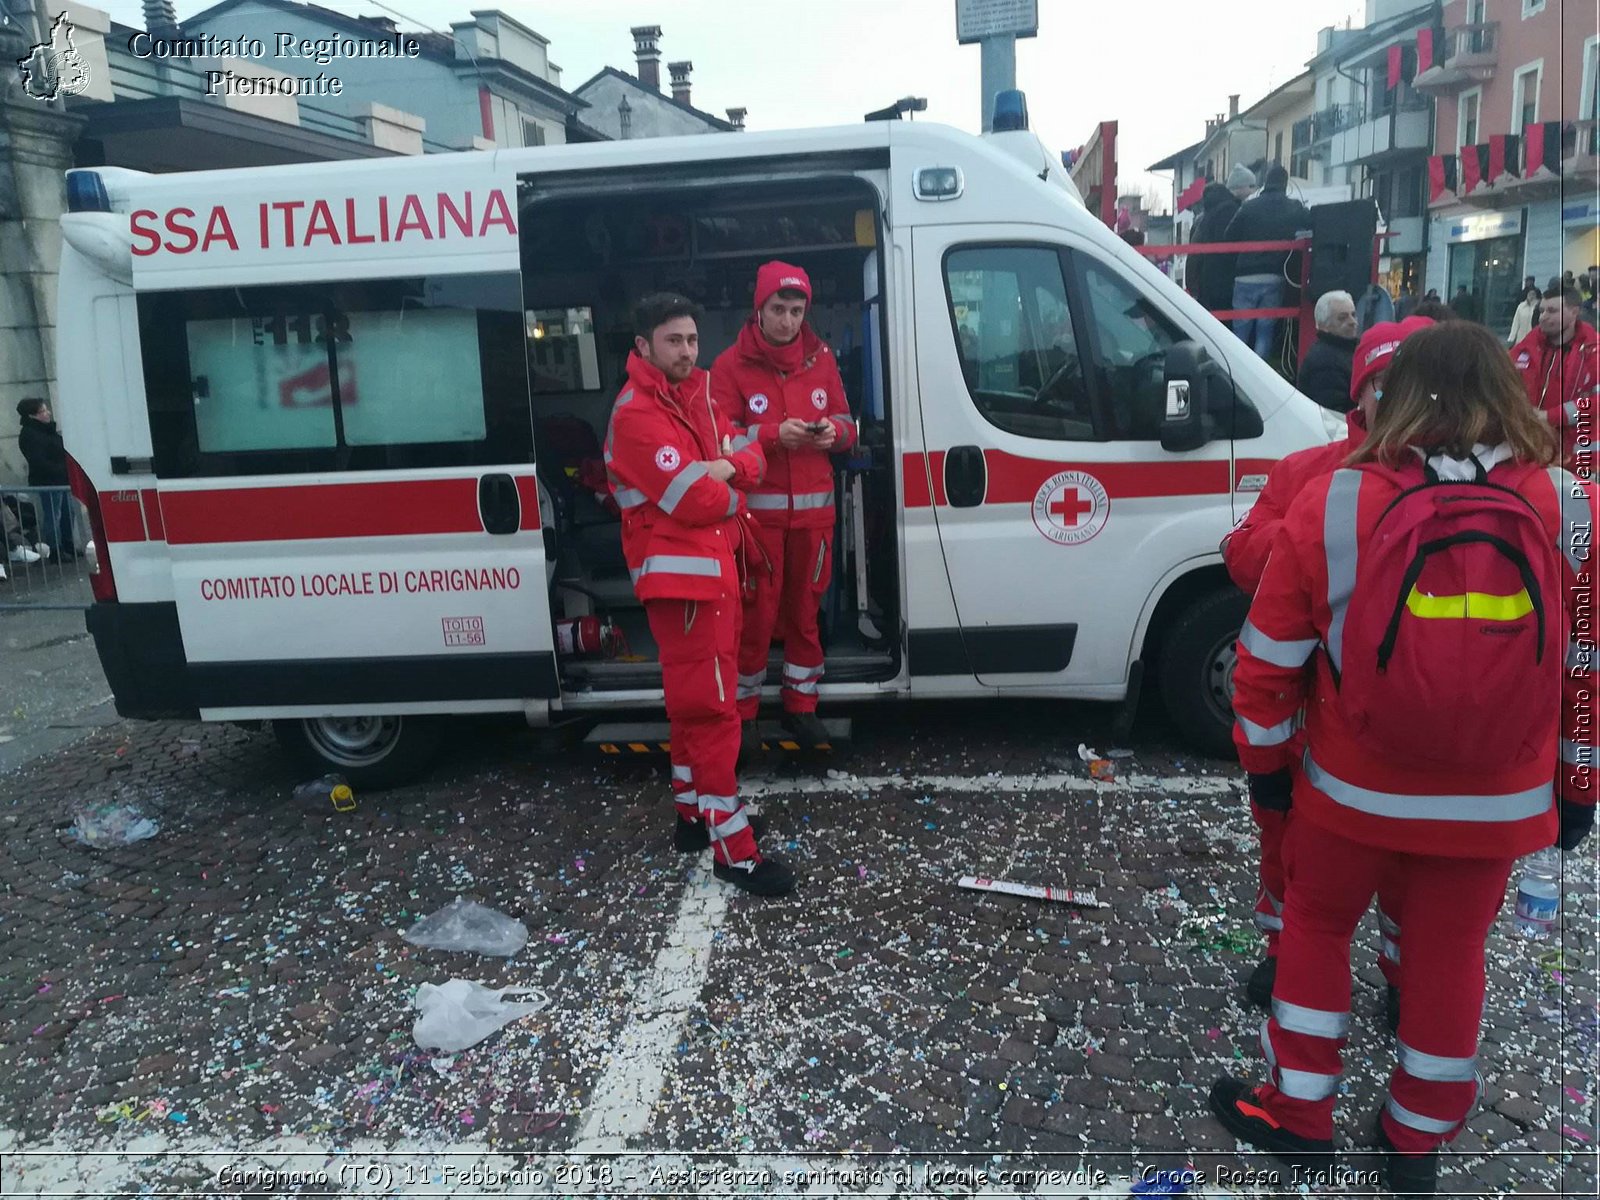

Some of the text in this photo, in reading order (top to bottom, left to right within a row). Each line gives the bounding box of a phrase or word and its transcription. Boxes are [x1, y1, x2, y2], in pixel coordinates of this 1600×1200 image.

[130, 188, 518, 257] SSA ITALIANA
[1052, 472, 1080, 486] ROSSA
[1081, 474, 1109, 512] ITALIAN
[1048, 524, 1097, 542] CARIGNANO
[200, 567, 521, 600] COMITATO LOCALE DI CARIGNANO
[445, 619, 480, 631] TO 10
[449, 633, 482, 644] 11-56
